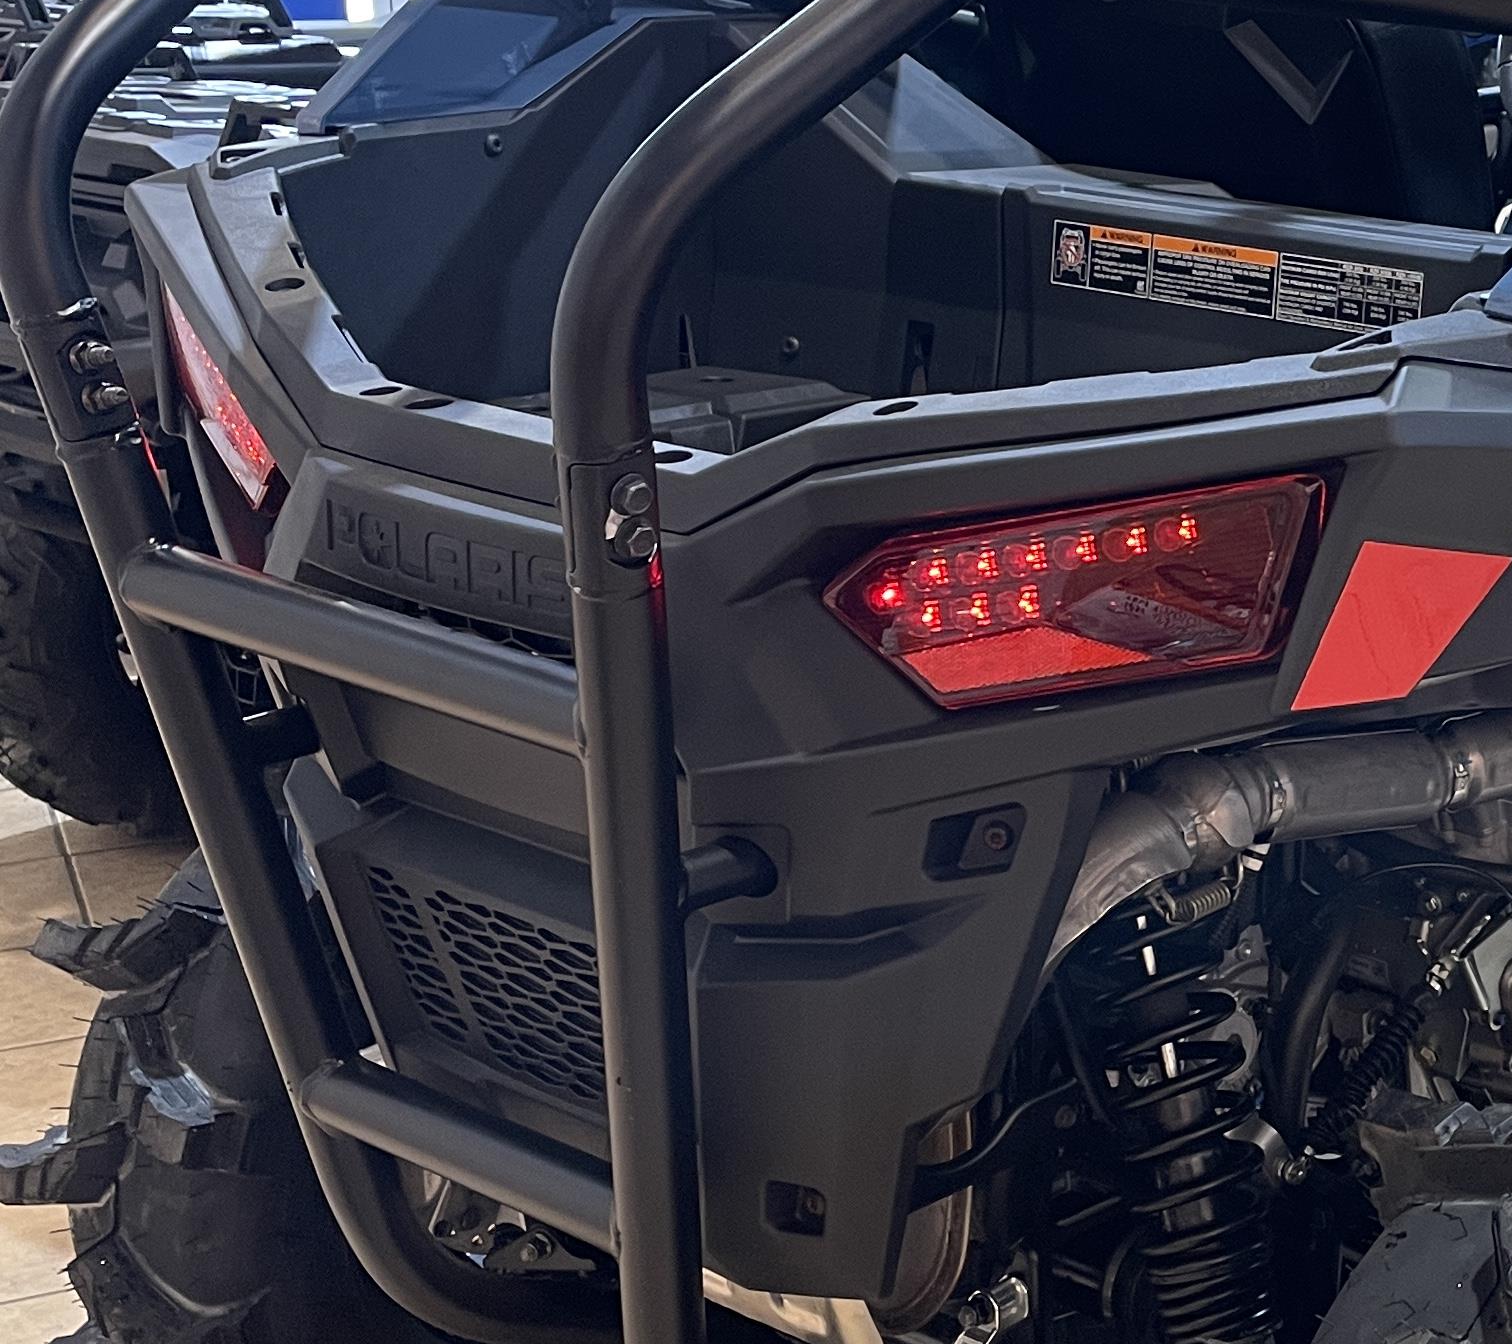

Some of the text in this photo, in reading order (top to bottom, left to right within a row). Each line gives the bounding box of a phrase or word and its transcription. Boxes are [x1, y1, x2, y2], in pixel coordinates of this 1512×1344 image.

[1109, 229, 1144, 244] WARNING
[1201, 243, 1237, 258] WARNING
[326, 498, 567, 608] POLARIS
